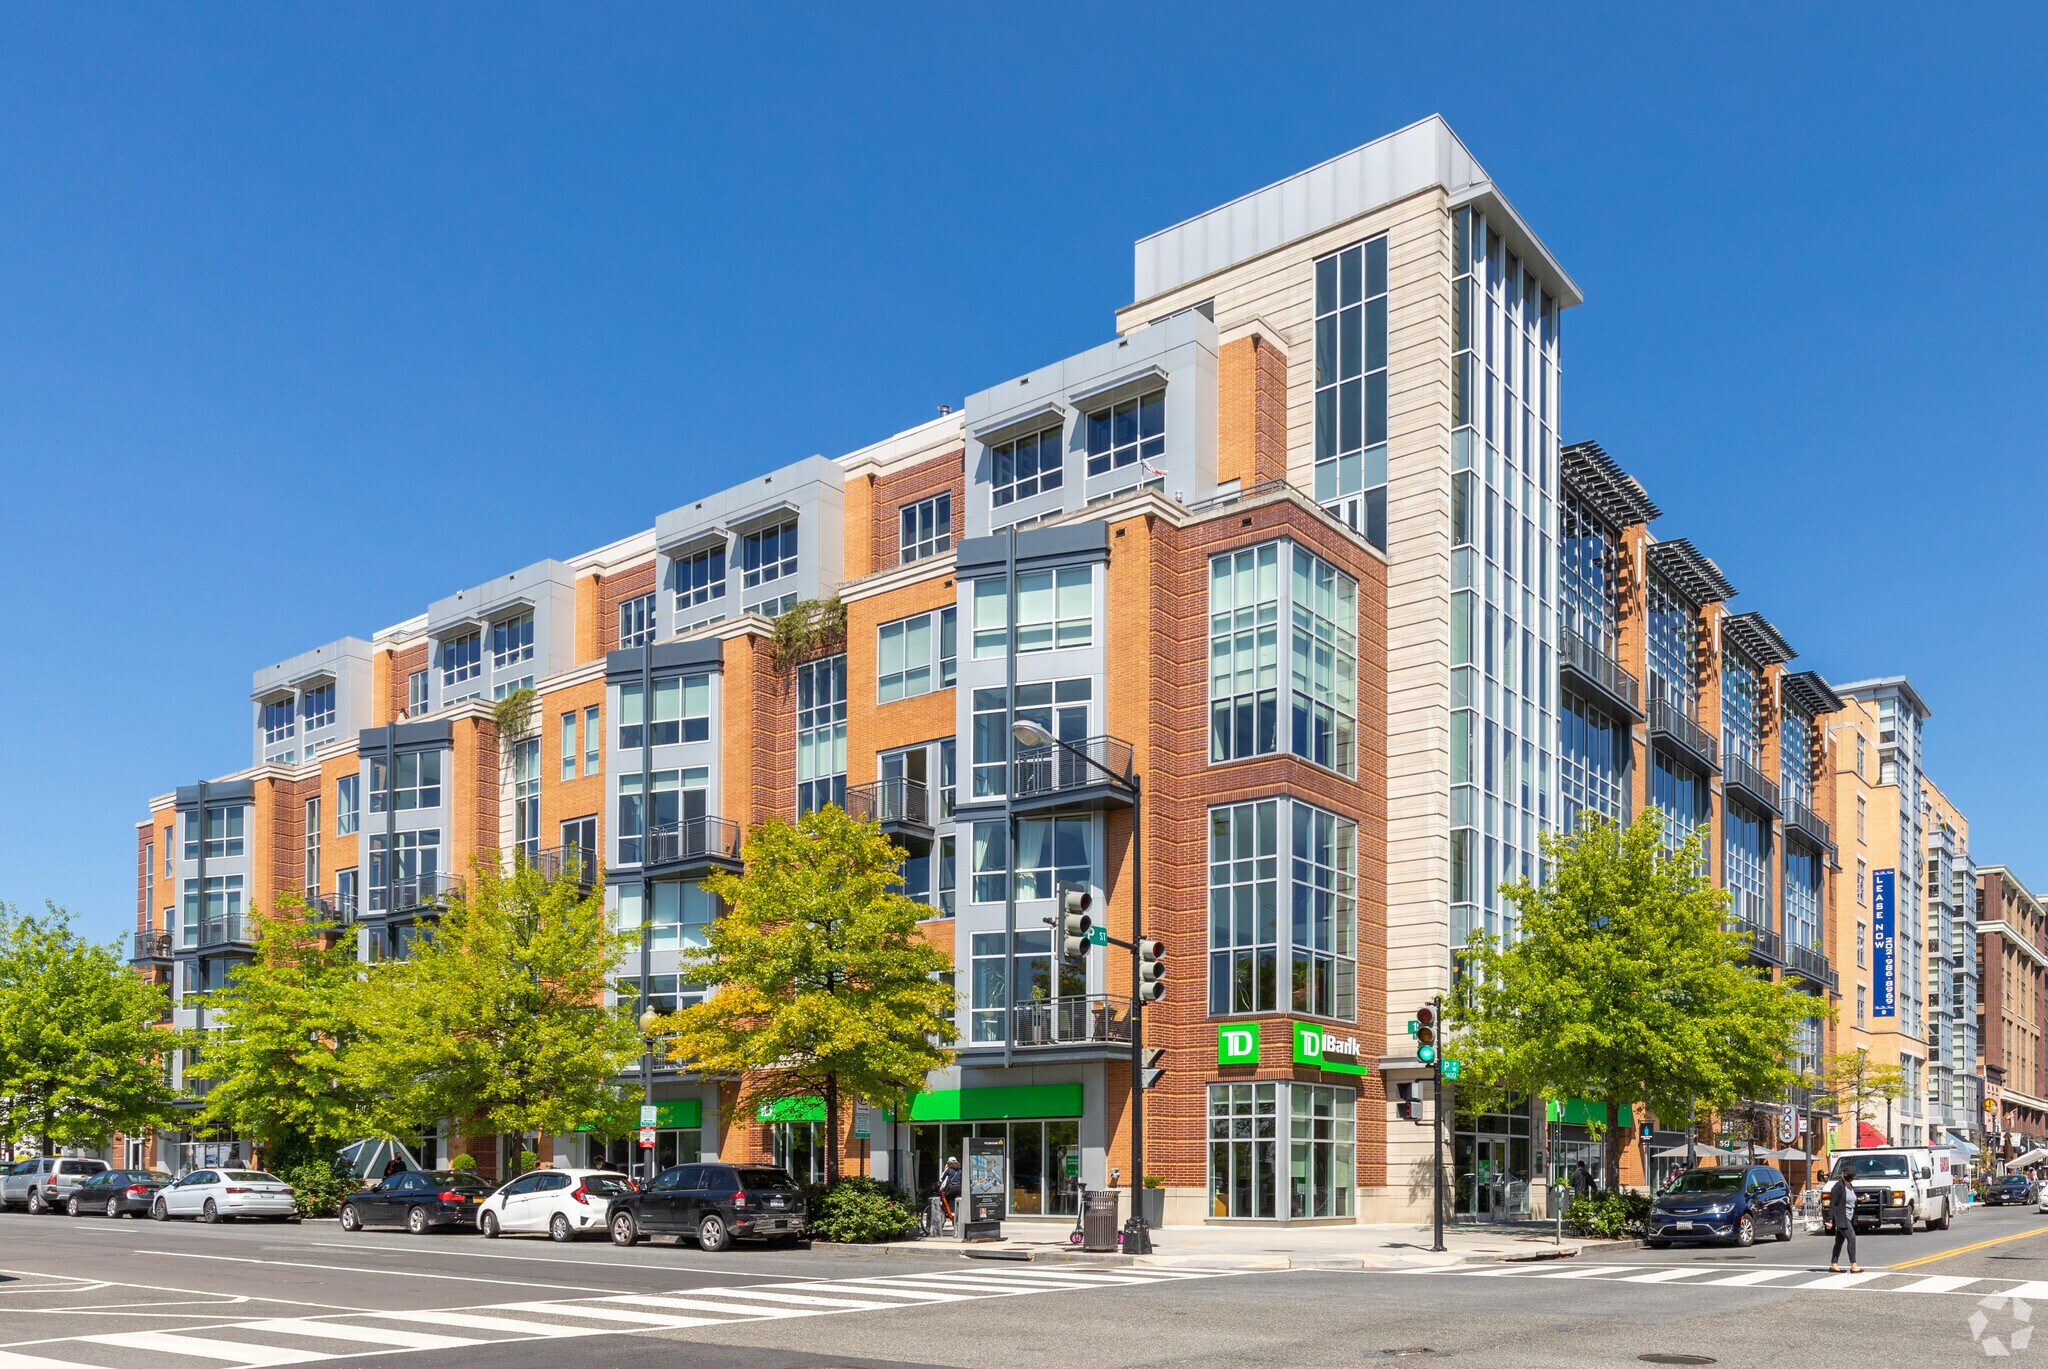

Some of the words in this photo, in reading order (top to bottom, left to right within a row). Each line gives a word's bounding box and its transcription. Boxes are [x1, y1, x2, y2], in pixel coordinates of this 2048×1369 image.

[1875, 876, 1884, 919] LEASE
[1099, 931, 1107, 942] ST
[1874, 923, 1885, 949] NOW
[1221, 1030, 1253, 1057] TD
[1300, 1030, 1320, 1057] TD
[1322, 1034, 1361, 1056] Bank
[1444, 1061, 1450, 1071] P
